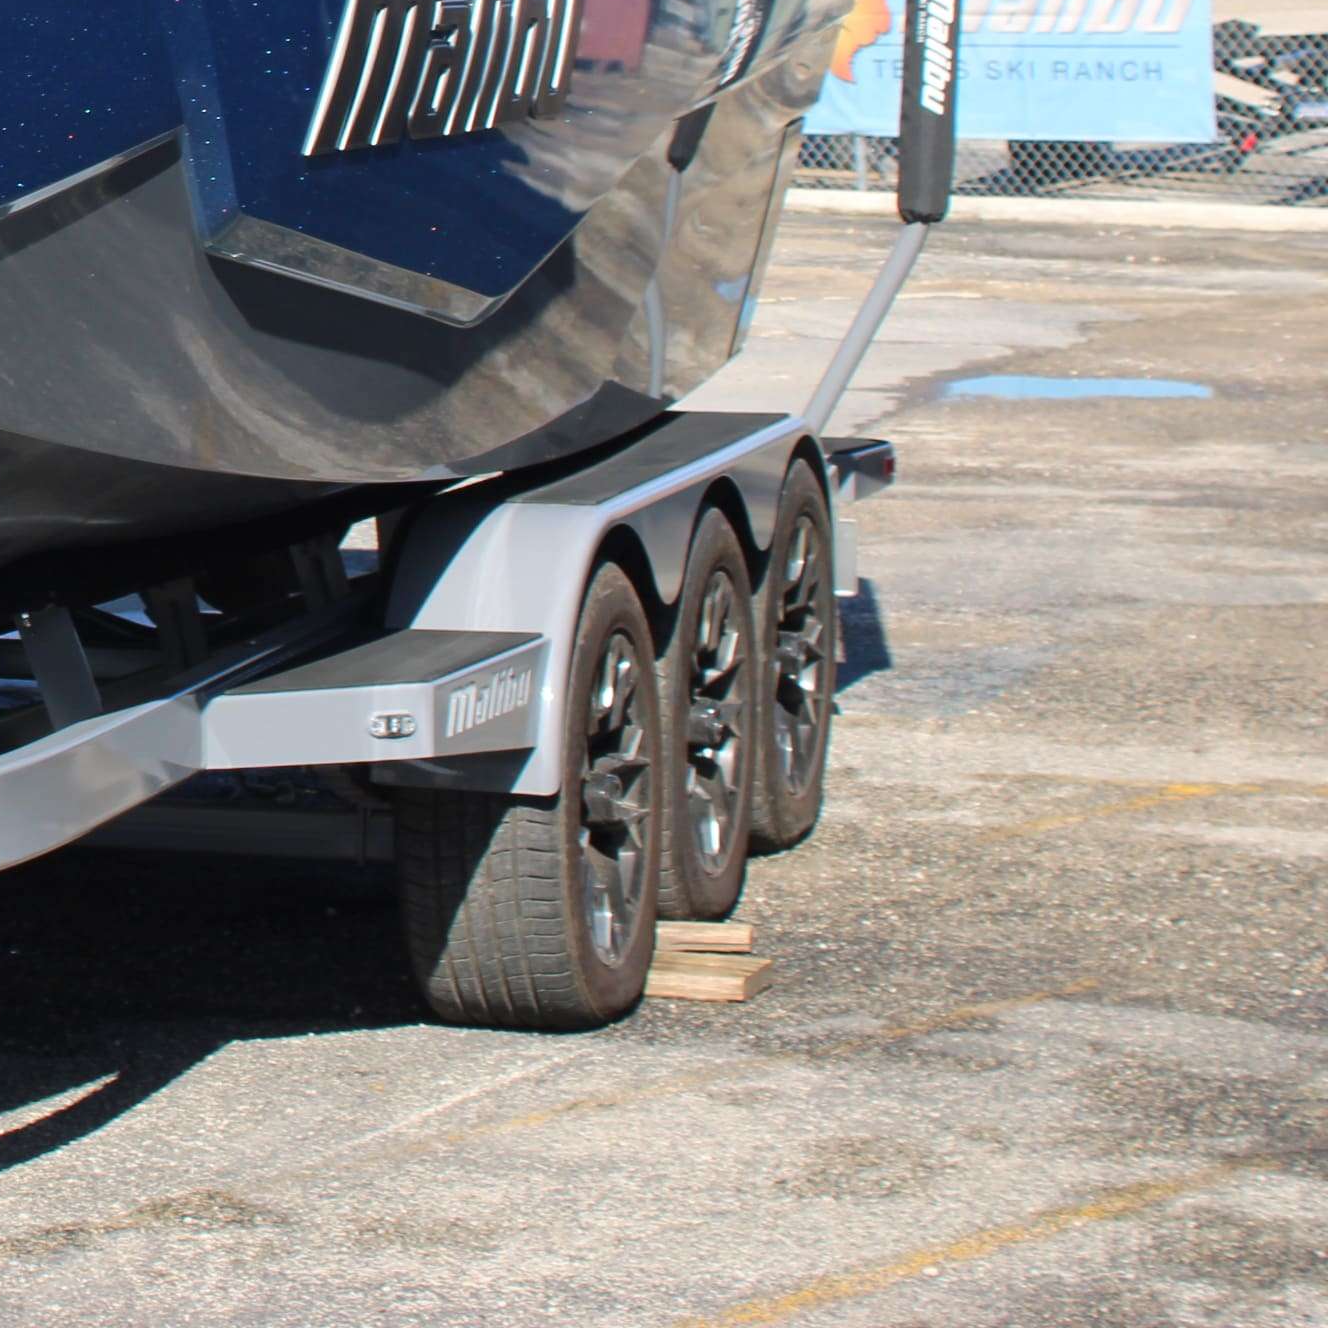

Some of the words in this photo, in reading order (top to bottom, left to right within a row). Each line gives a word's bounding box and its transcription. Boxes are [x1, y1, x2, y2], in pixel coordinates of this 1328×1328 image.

[873, 59, 971, 80] TES
[984, 60, 1035, 81] SKI
[1053, 61, 1163, 81] RANCH
[445, 667, 533, 738] Malibu
